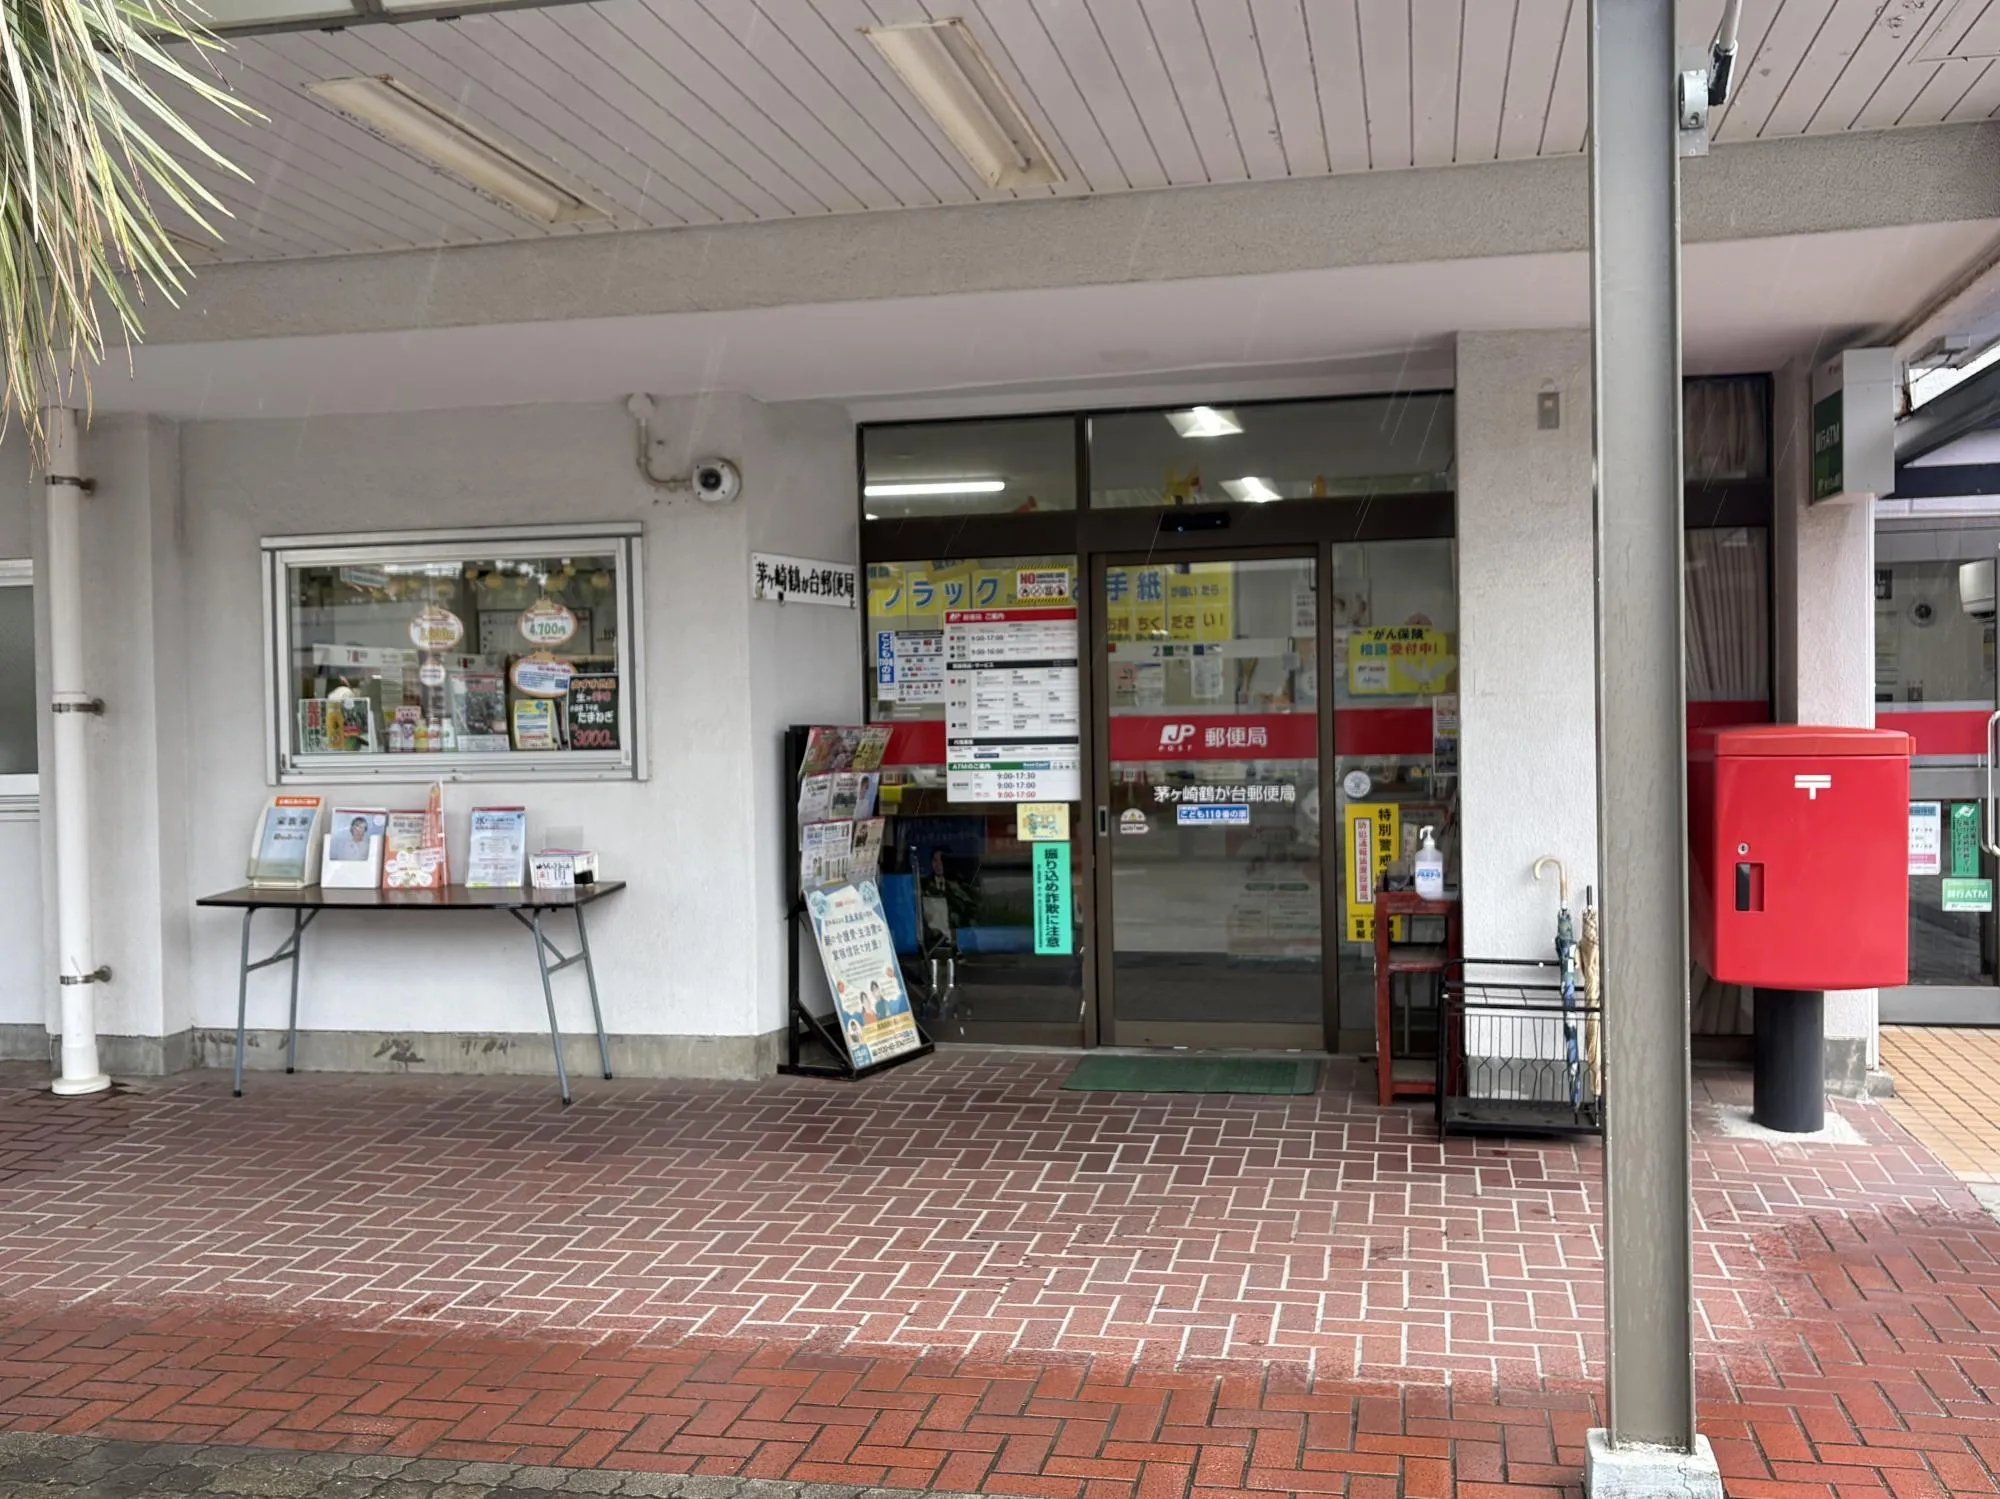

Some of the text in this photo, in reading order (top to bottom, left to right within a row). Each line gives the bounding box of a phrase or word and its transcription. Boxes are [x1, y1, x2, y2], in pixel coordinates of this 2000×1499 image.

[1205, 727, 1268, 748] 郵便局
[1153, 785, 1297, 803] 茅ヶ崎鶴が台郵便局
[1044, 847, 1060, 948] 振り込め詐欺に注意
